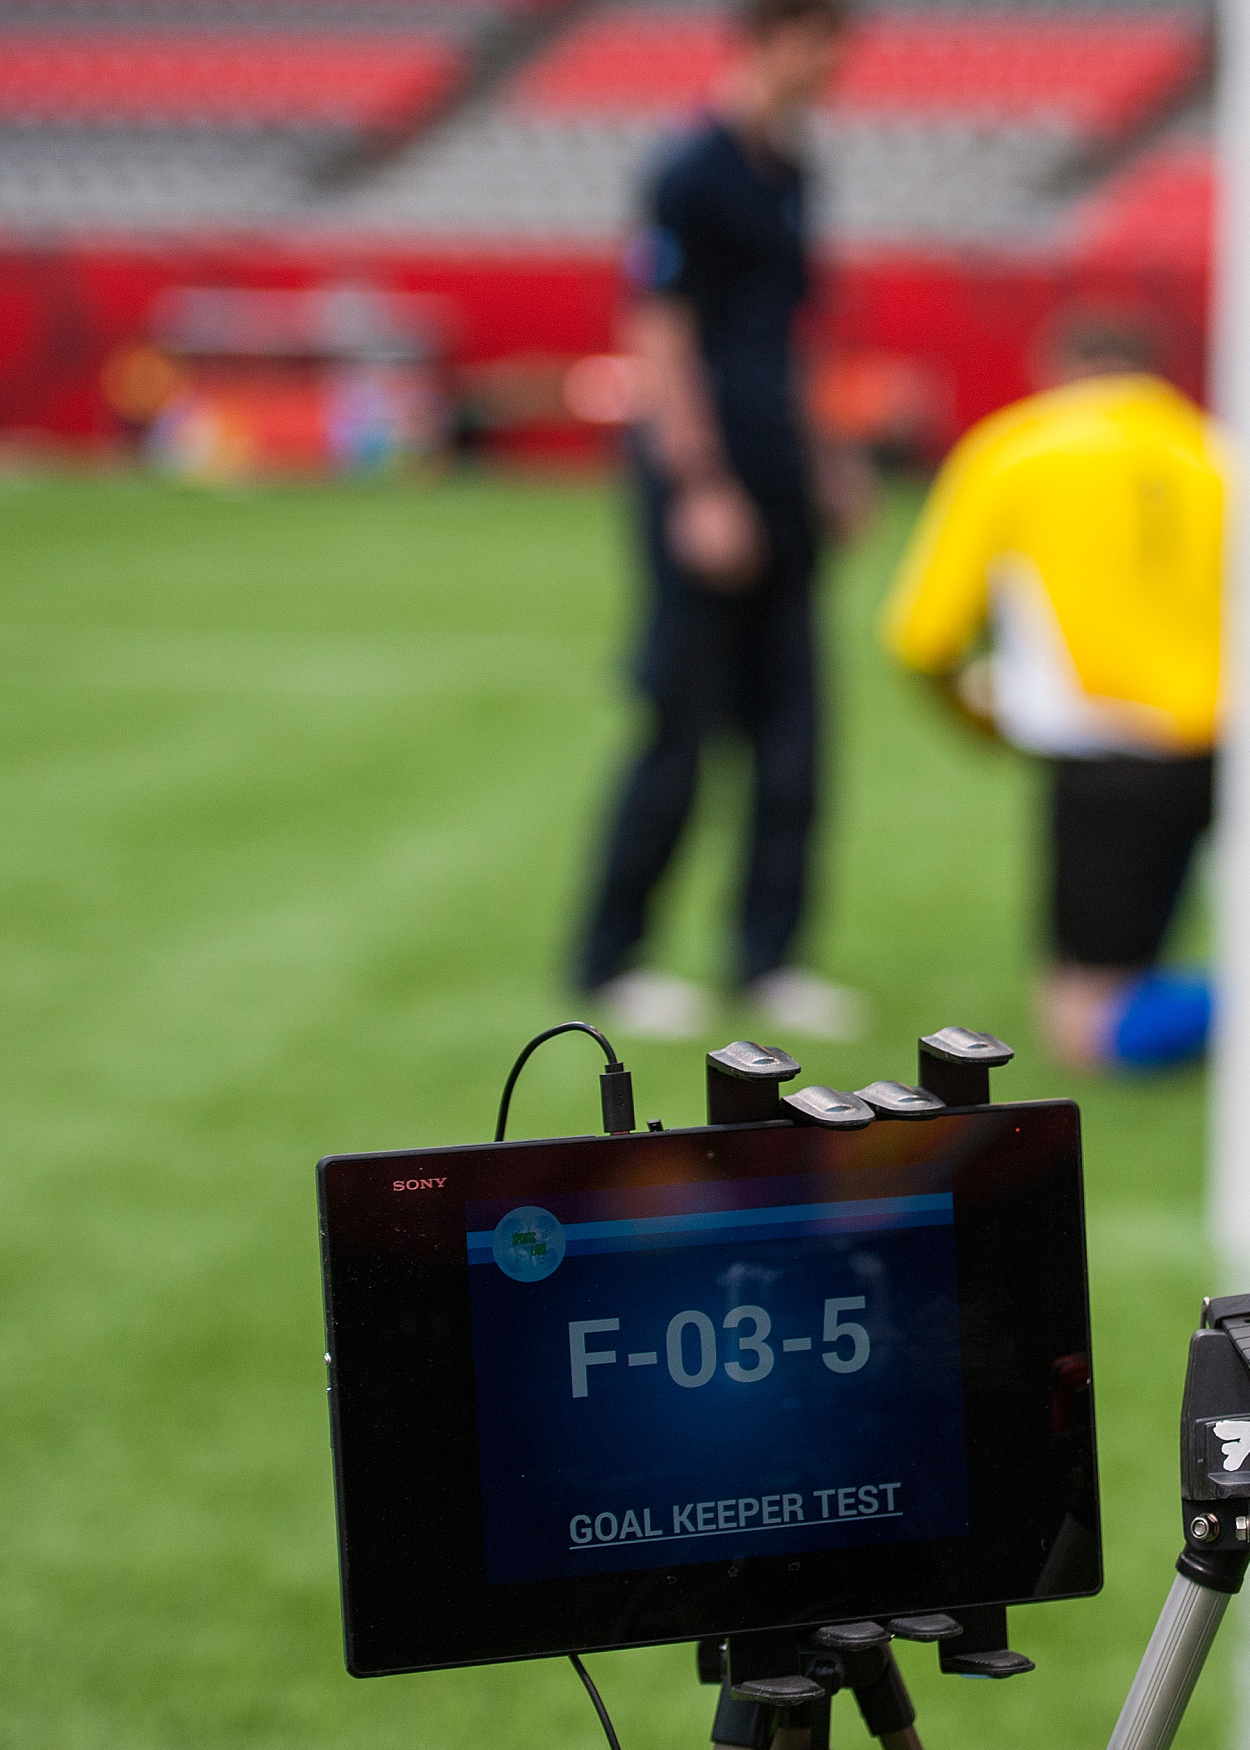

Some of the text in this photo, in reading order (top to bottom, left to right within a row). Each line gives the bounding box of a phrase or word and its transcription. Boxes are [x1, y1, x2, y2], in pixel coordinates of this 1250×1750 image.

[392, 1177, 448, 1192] SONY
[568, 1295, 871, 1398] F-03-5
[569, 1483, 901, 1545] GOAL KEEPER TEST
